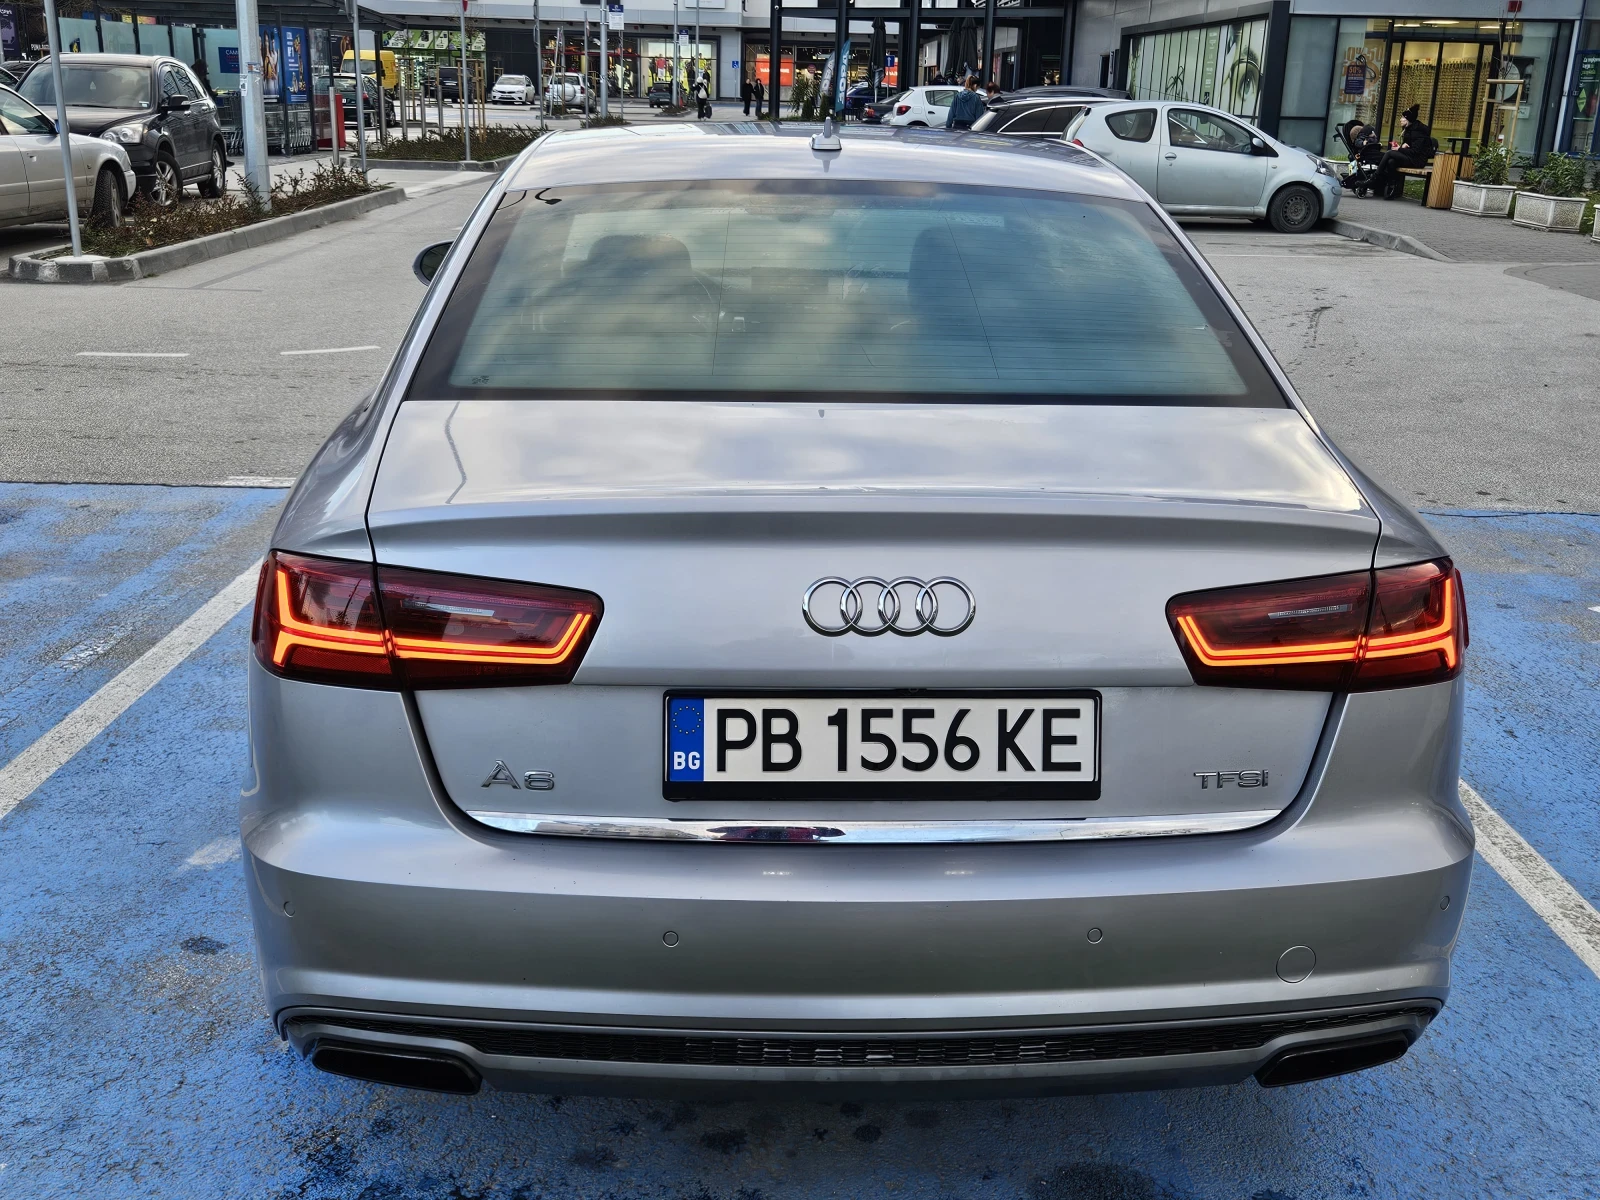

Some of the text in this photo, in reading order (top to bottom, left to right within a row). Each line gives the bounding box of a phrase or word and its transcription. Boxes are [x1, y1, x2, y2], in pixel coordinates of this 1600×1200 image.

[716, 708, 1083, 772] PB 1556 KE
[673, 752, 701, 770] BG
[481, 760, 555, 790] A6
[1193, 770, 1269, 789] TFSI
